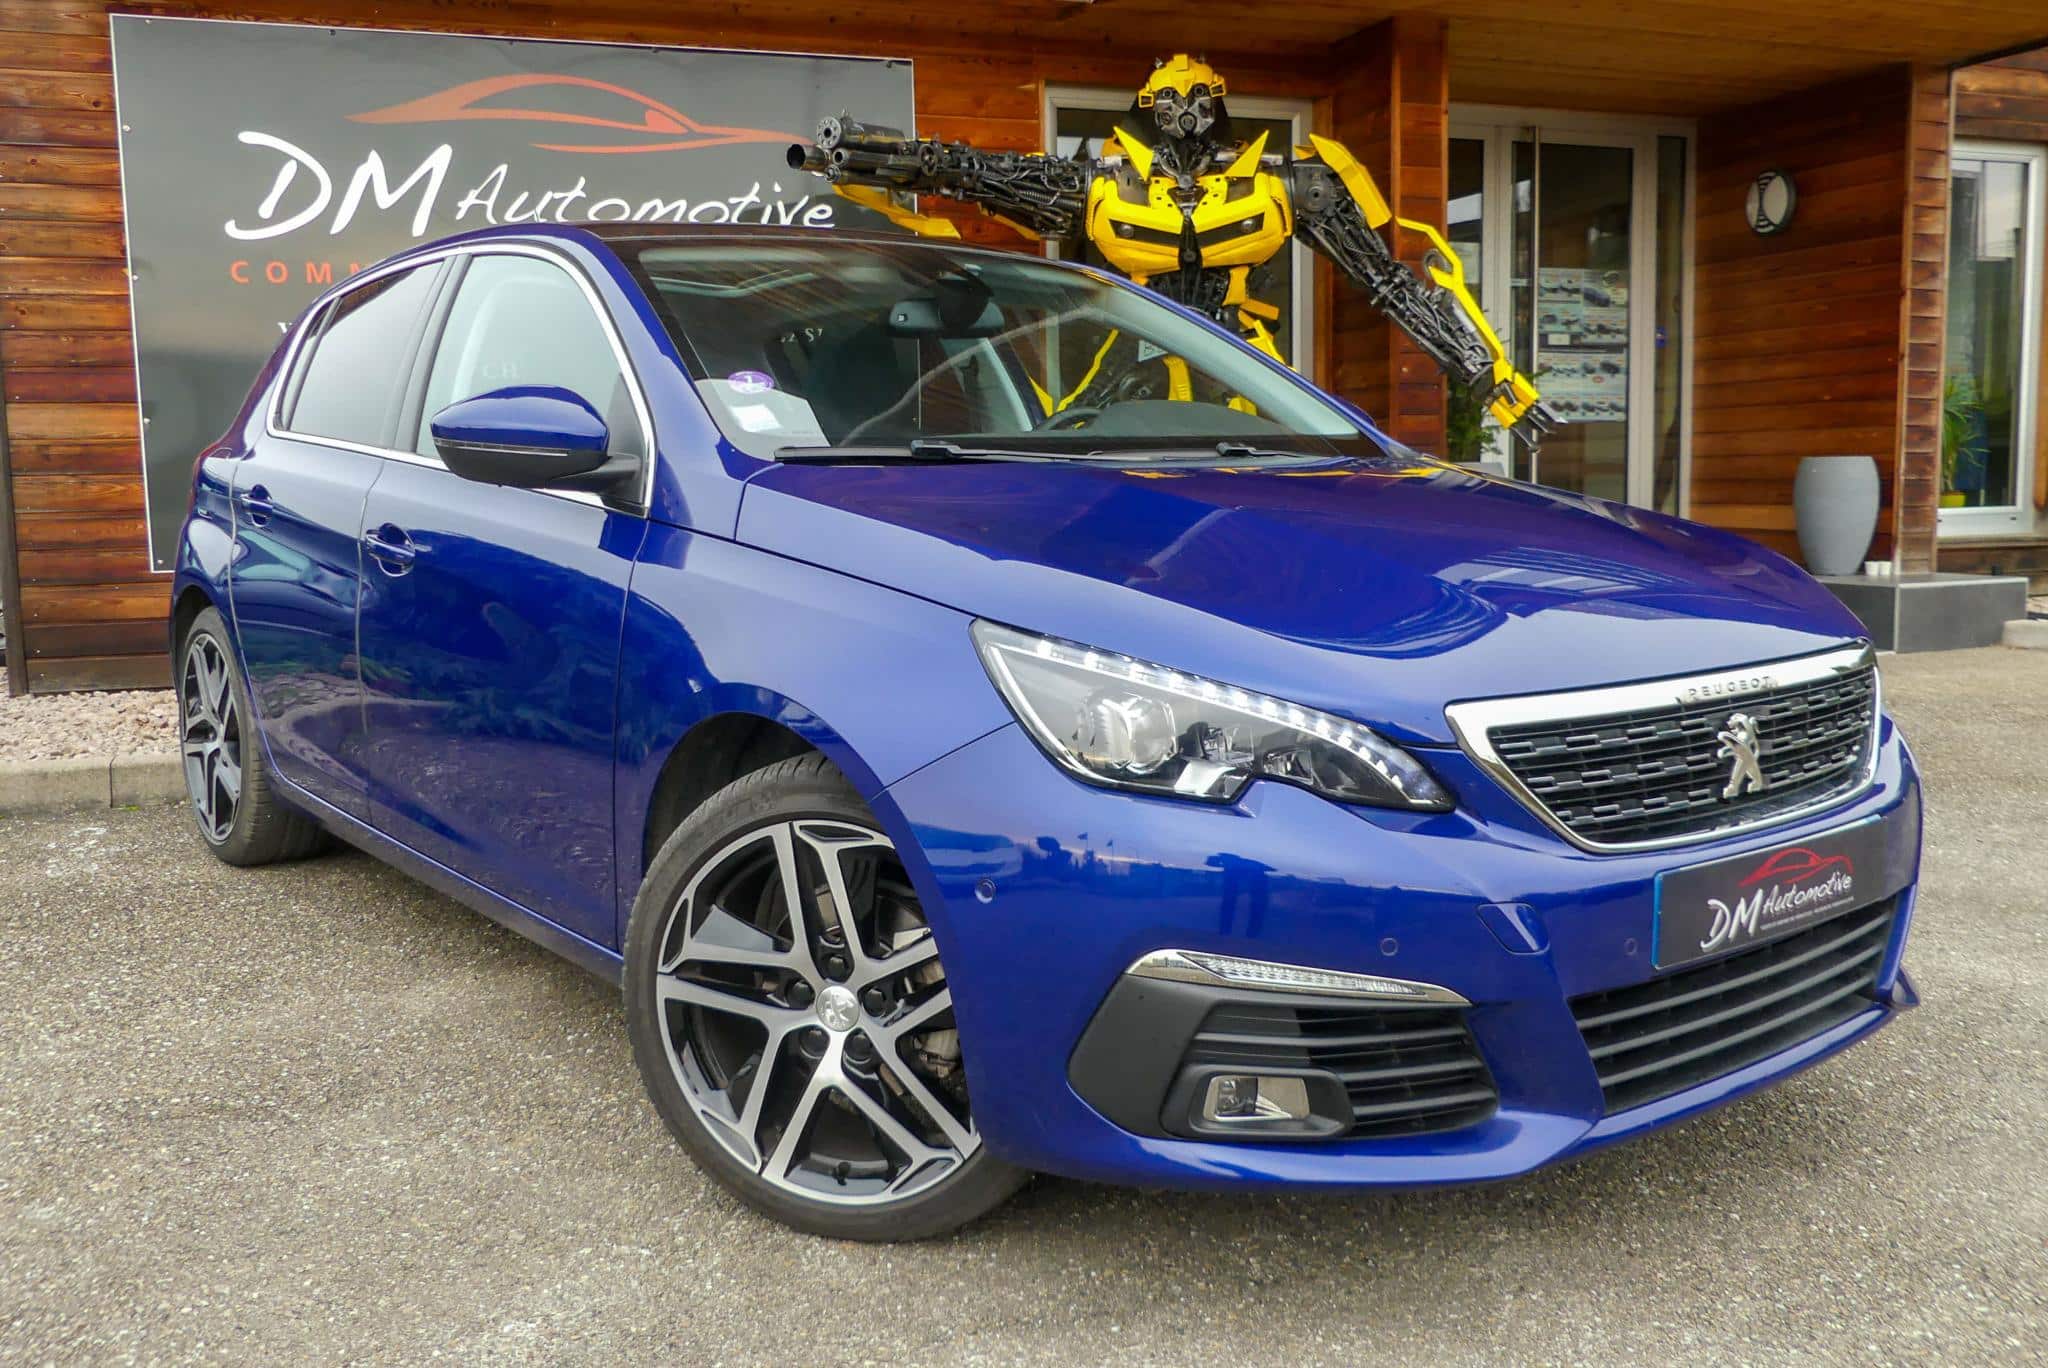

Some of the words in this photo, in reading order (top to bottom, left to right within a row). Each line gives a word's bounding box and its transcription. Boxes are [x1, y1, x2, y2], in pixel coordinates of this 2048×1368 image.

[224, 131, 452, 239] DM
[455, 164, 835, 228] Automotive
[1687, 675, 1769, 697] PEUGEOT
[1701, 888, 1763, 952] DM
[1762, 872, 1852, 914] Automotive
